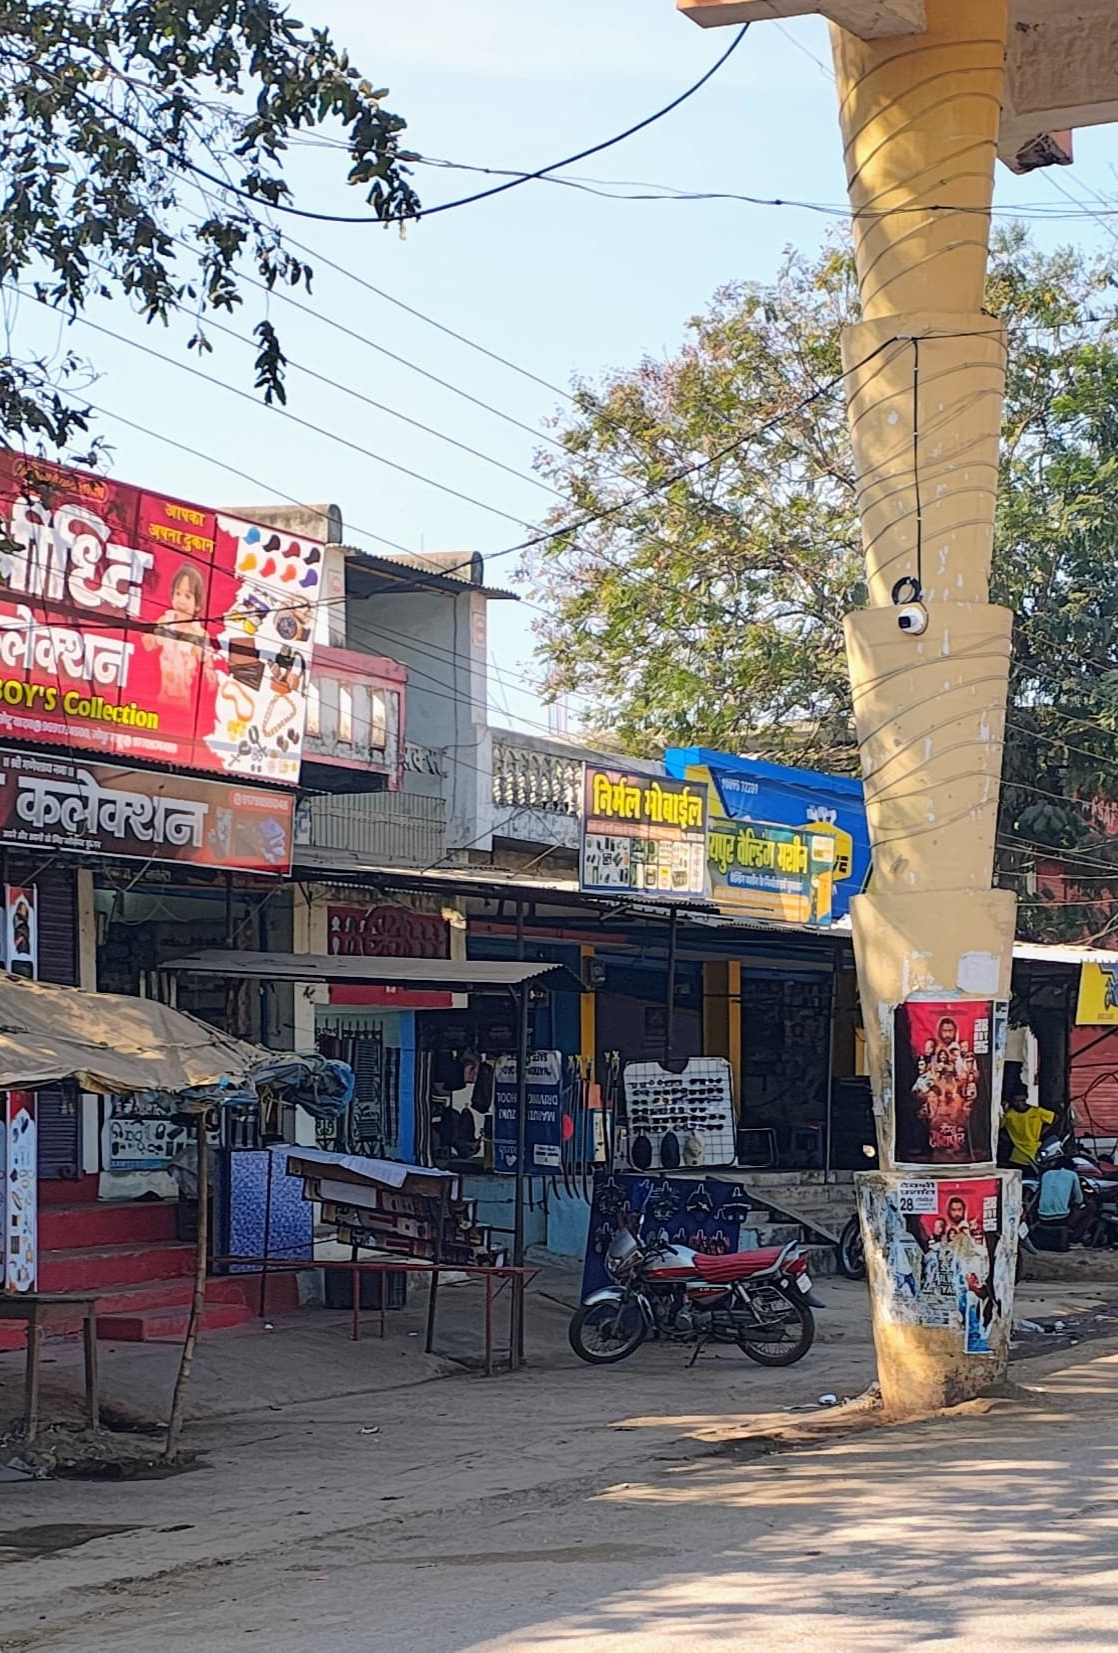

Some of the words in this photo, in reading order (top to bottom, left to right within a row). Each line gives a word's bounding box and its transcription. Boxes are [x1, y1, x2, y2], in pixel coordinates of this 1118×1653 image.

[164, 502, 207, 527] आपका
[147, 522, 184, 545] अपना
[181, 532, 215, 554] दुकान
[0, 603, 136, 688] लेक्शन
[62, 690, 160, 730] Collection
[16, 768, 209, 849] कलेक्शन
[592, 773, 642, 819] निर्मल
[644, 781, 703, 830] मोबाईल
[900, 1198, 914, 1212] 28
